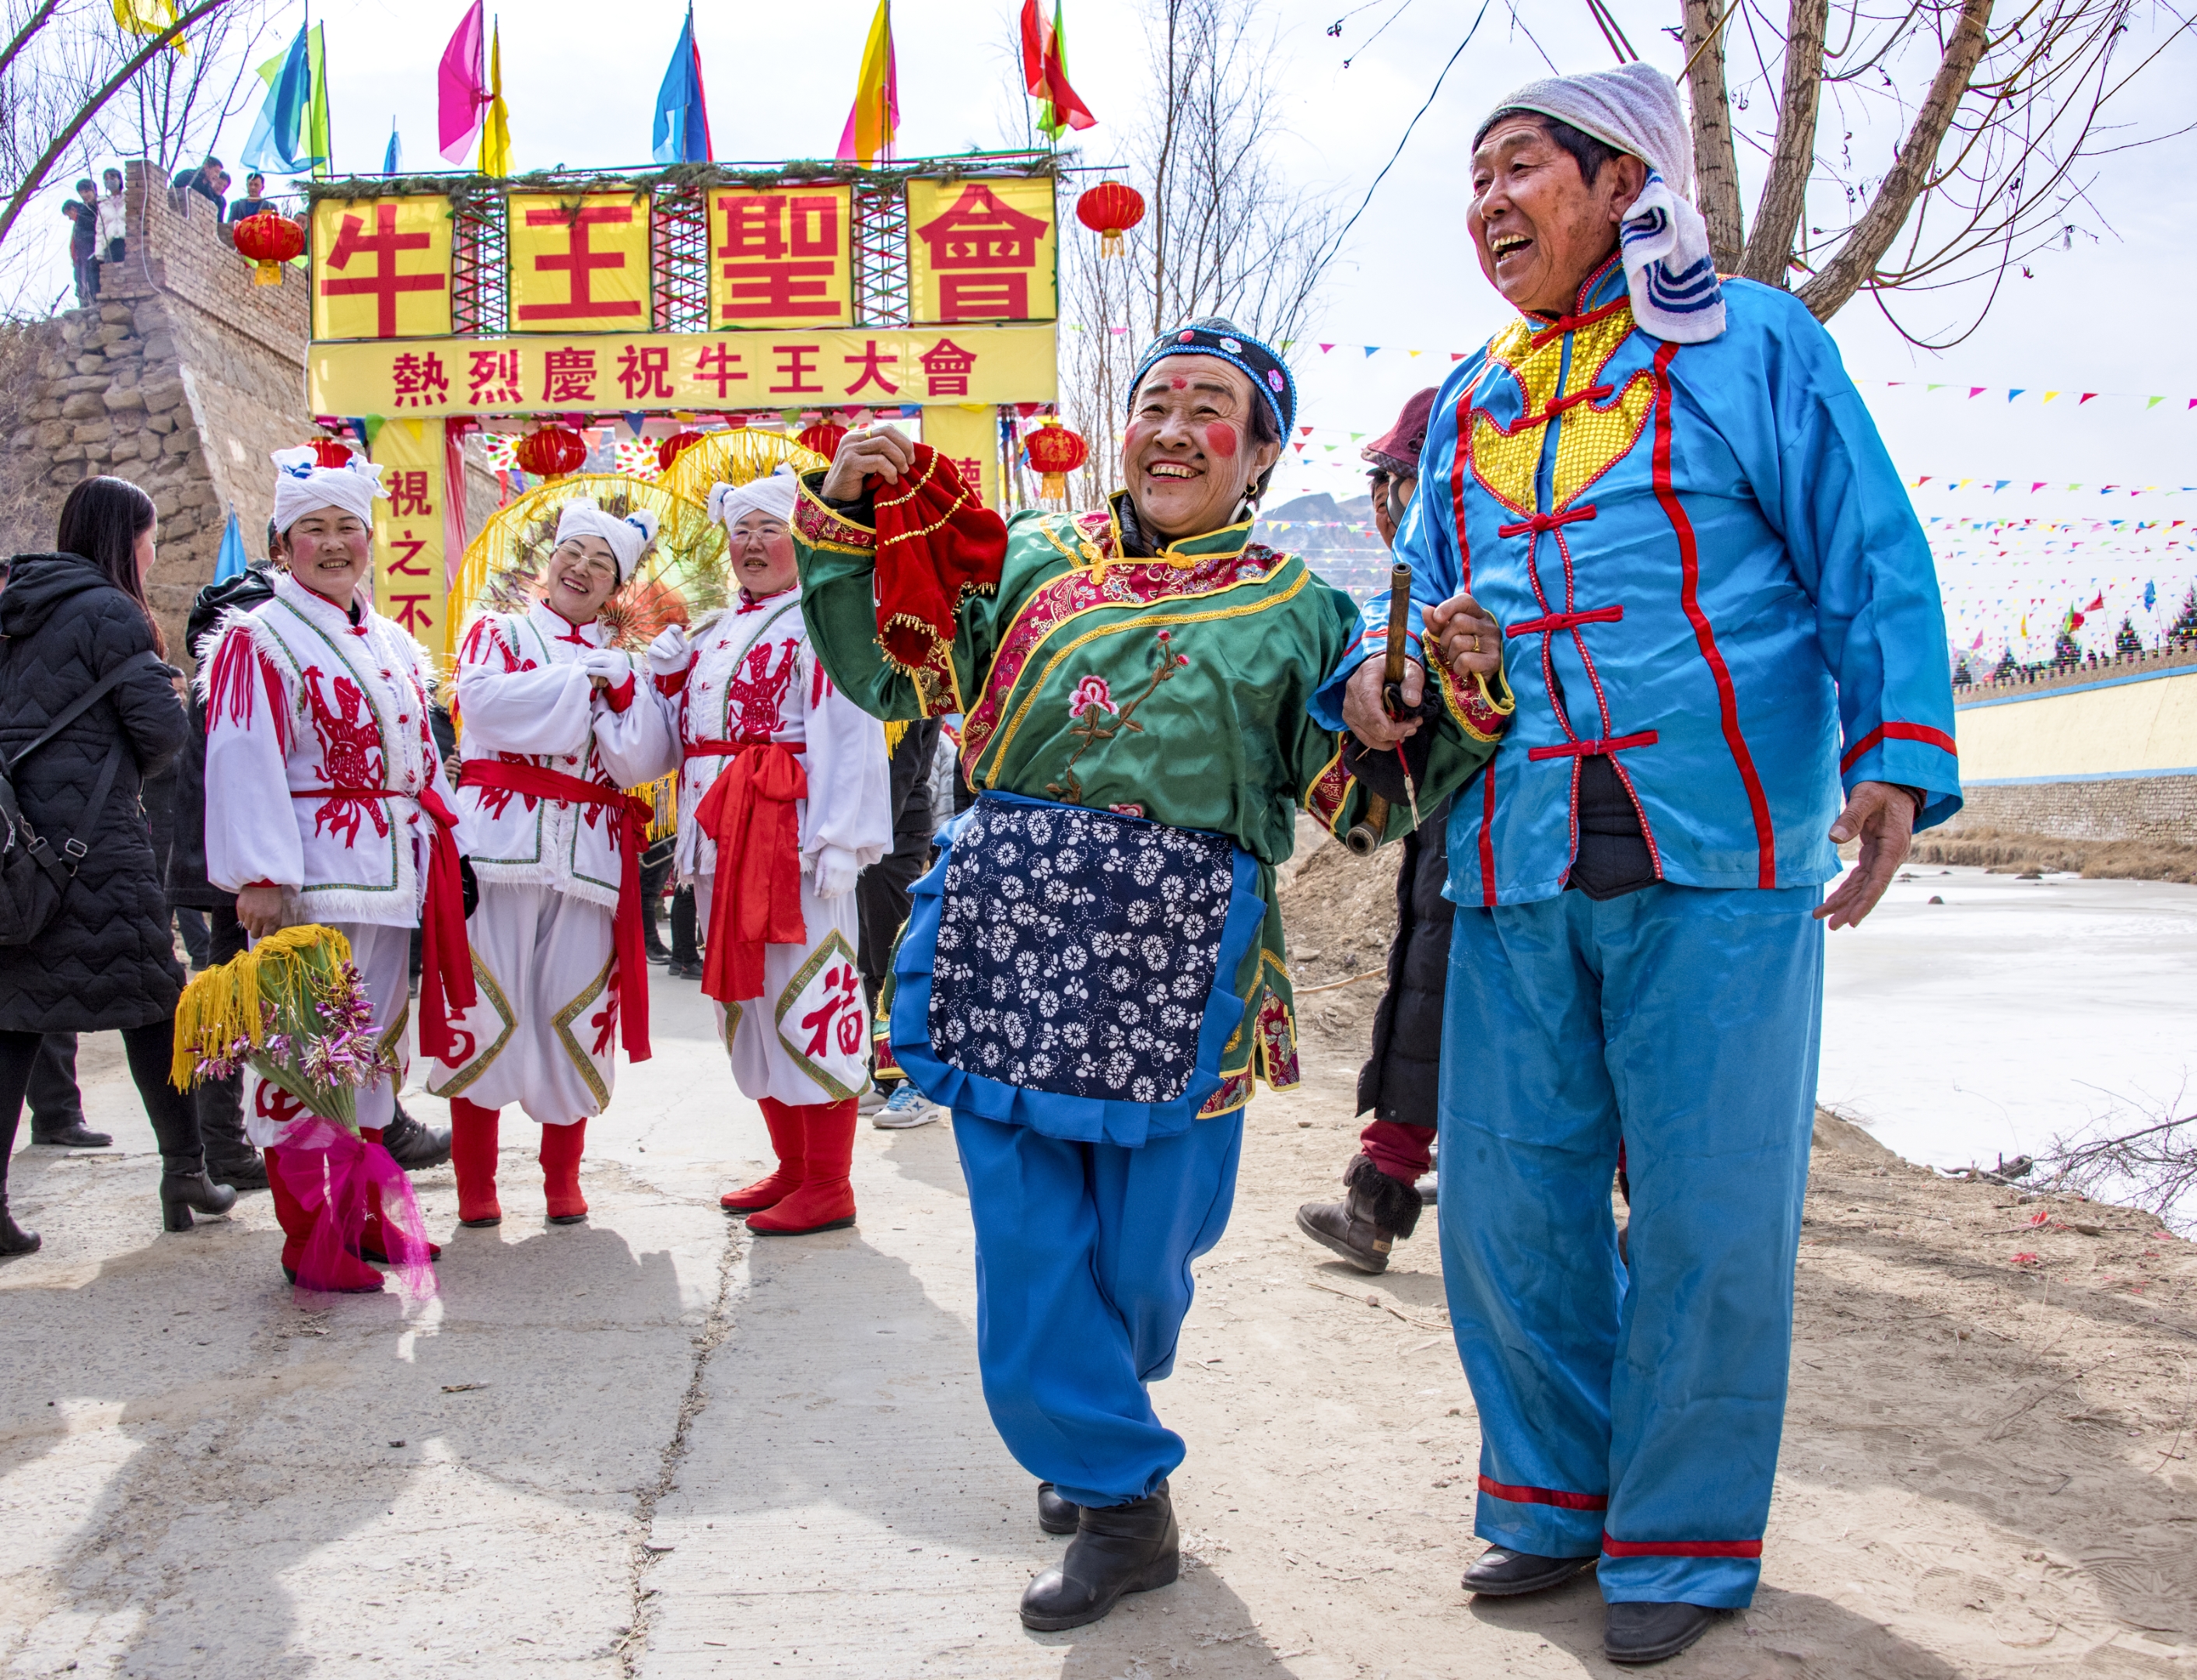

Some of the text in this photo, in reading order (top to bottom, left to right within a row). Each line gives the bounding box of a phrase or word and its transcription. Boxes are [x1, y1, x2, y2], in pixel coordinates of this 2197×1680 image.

[321, 184, 1049, 338] 牛王聖會
[392, 338, 978, 408] 熱烈慶祝牛王大會
[386, 470, 433, 636] 視之不
[801, 962, 864, 1058] 福
